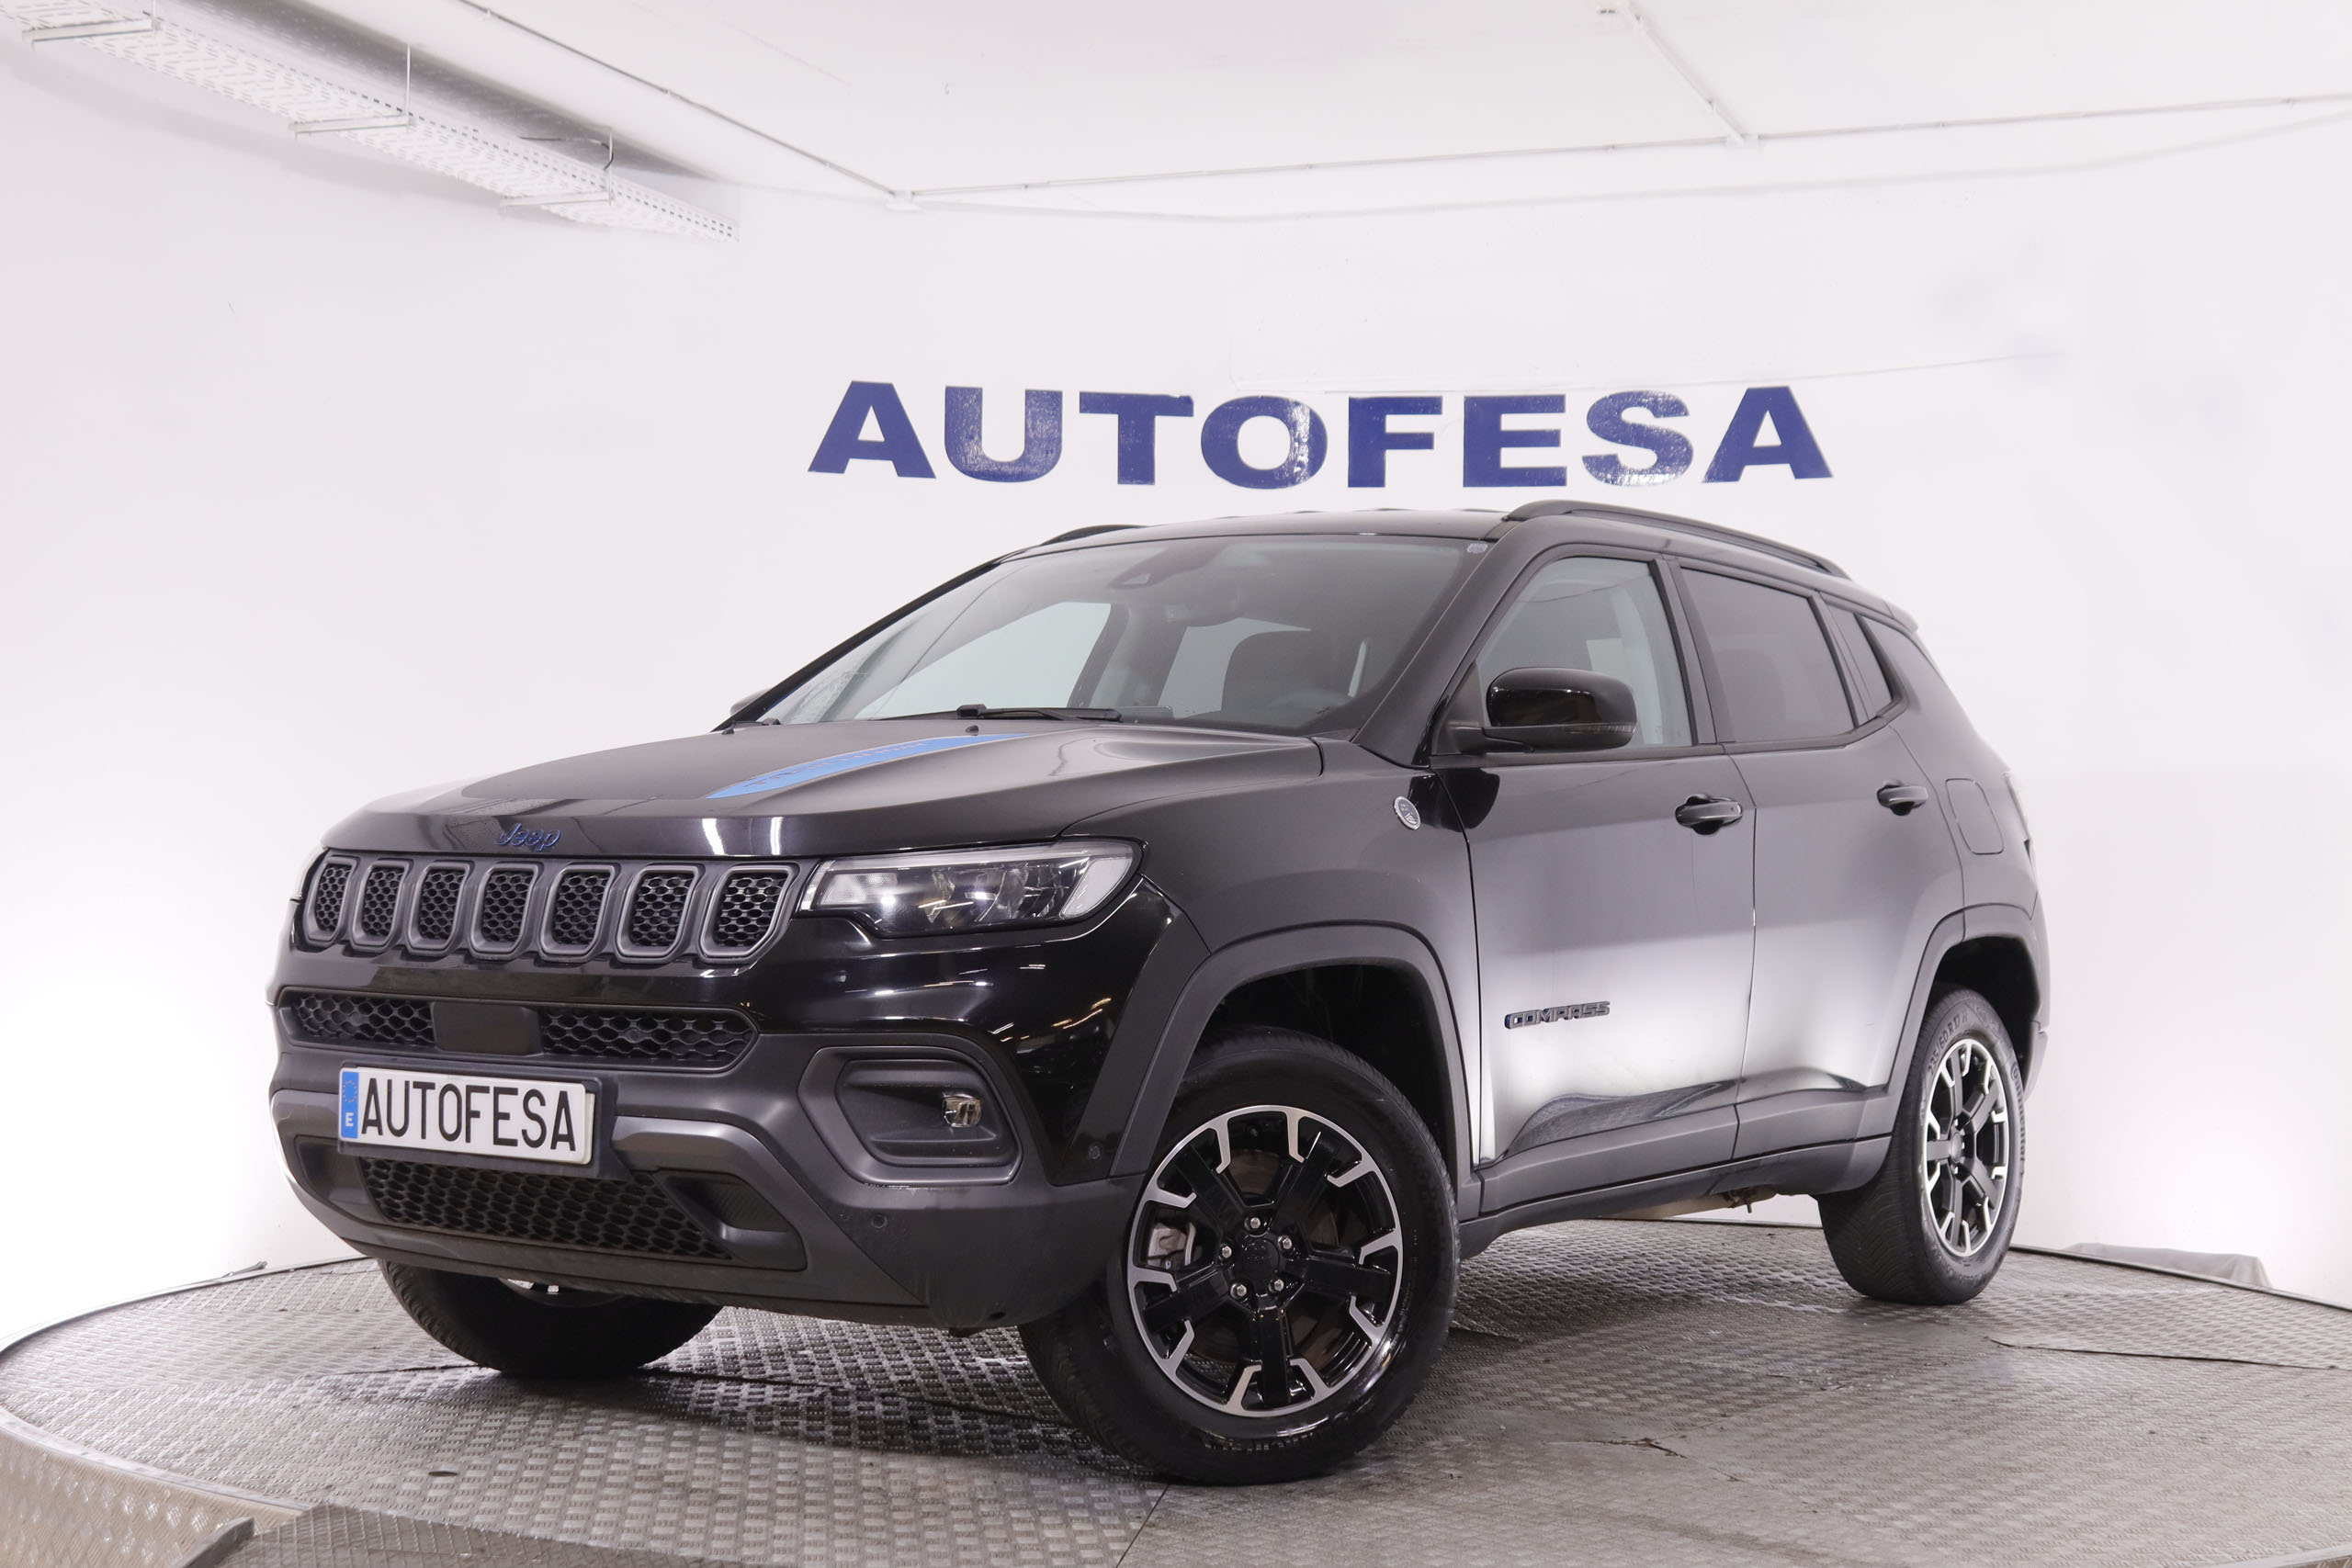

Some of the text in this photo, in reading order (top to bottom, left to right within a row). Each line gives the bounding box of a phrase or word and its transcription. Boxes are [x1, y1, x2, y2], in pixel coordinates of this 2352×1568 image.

[807, 380, 1834, 490] AUTOFESA
[495, 822, 561, 852] Jeep
[1504, 1000, 1611, 1030] COMPASS
[345, 1111, 355, 1127] E
[361, 1077, 576, 1152] AUTOFESA
